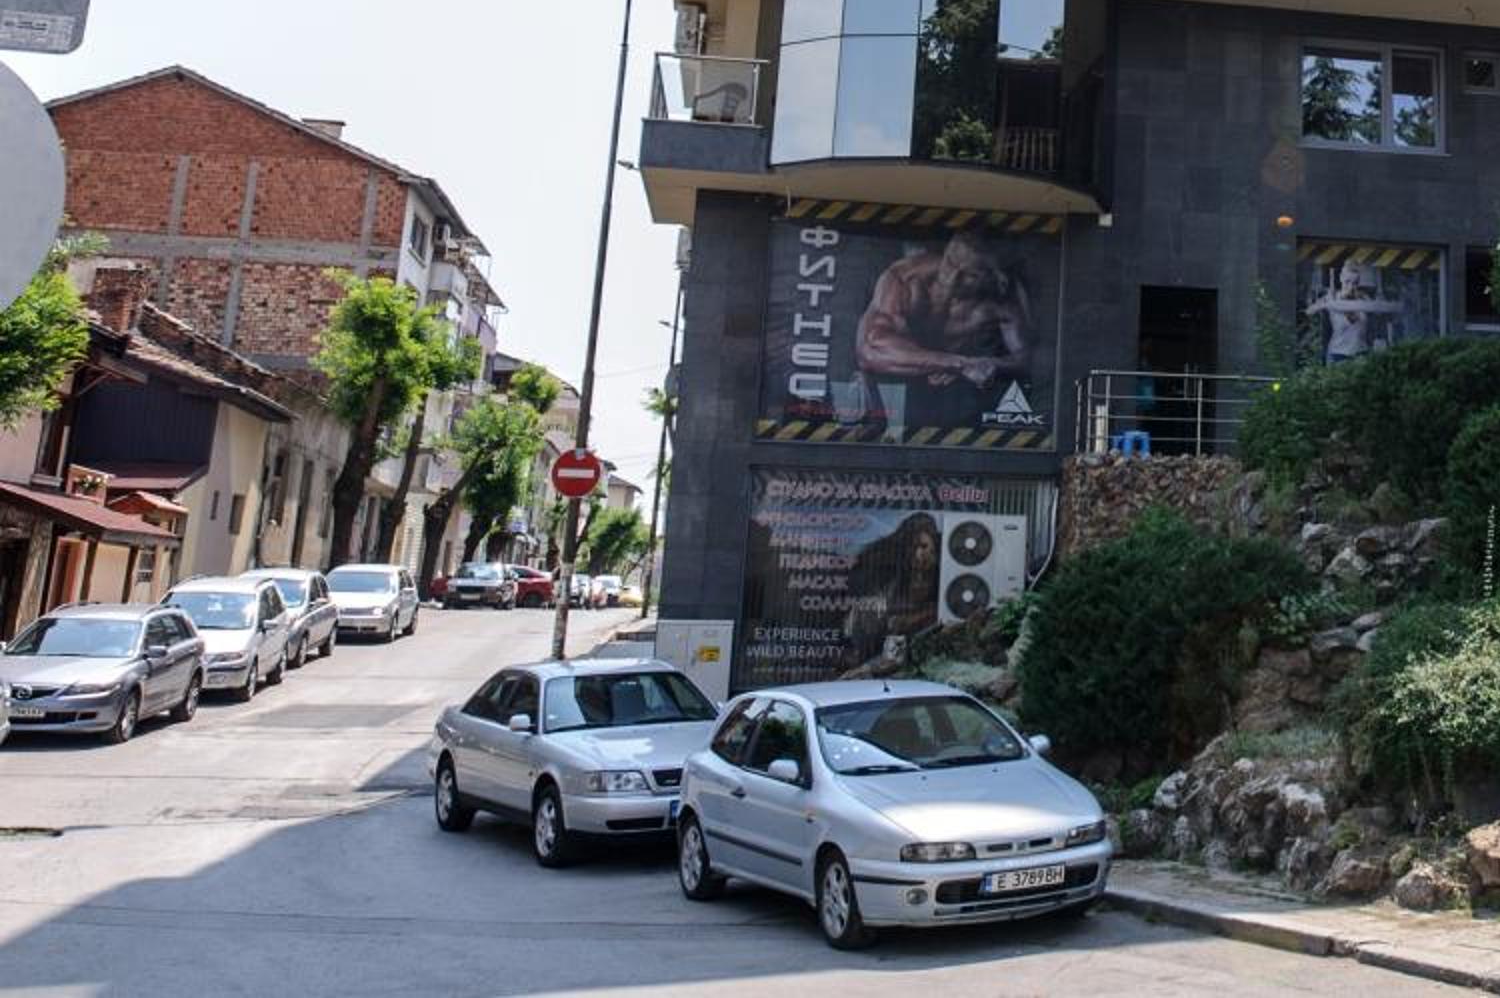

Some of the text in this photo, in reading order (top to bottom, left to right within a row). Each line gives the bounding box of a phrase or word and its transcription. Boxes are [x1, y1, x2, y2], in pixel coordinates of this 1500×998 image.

[788, 224, 840, 398] ФИТНЕС
[981, 412, 1048, 425] PEAK
[753, 627, 841, 642] EXPERIENCE
[746, 644, 845, 660] WILD BEAUTY
